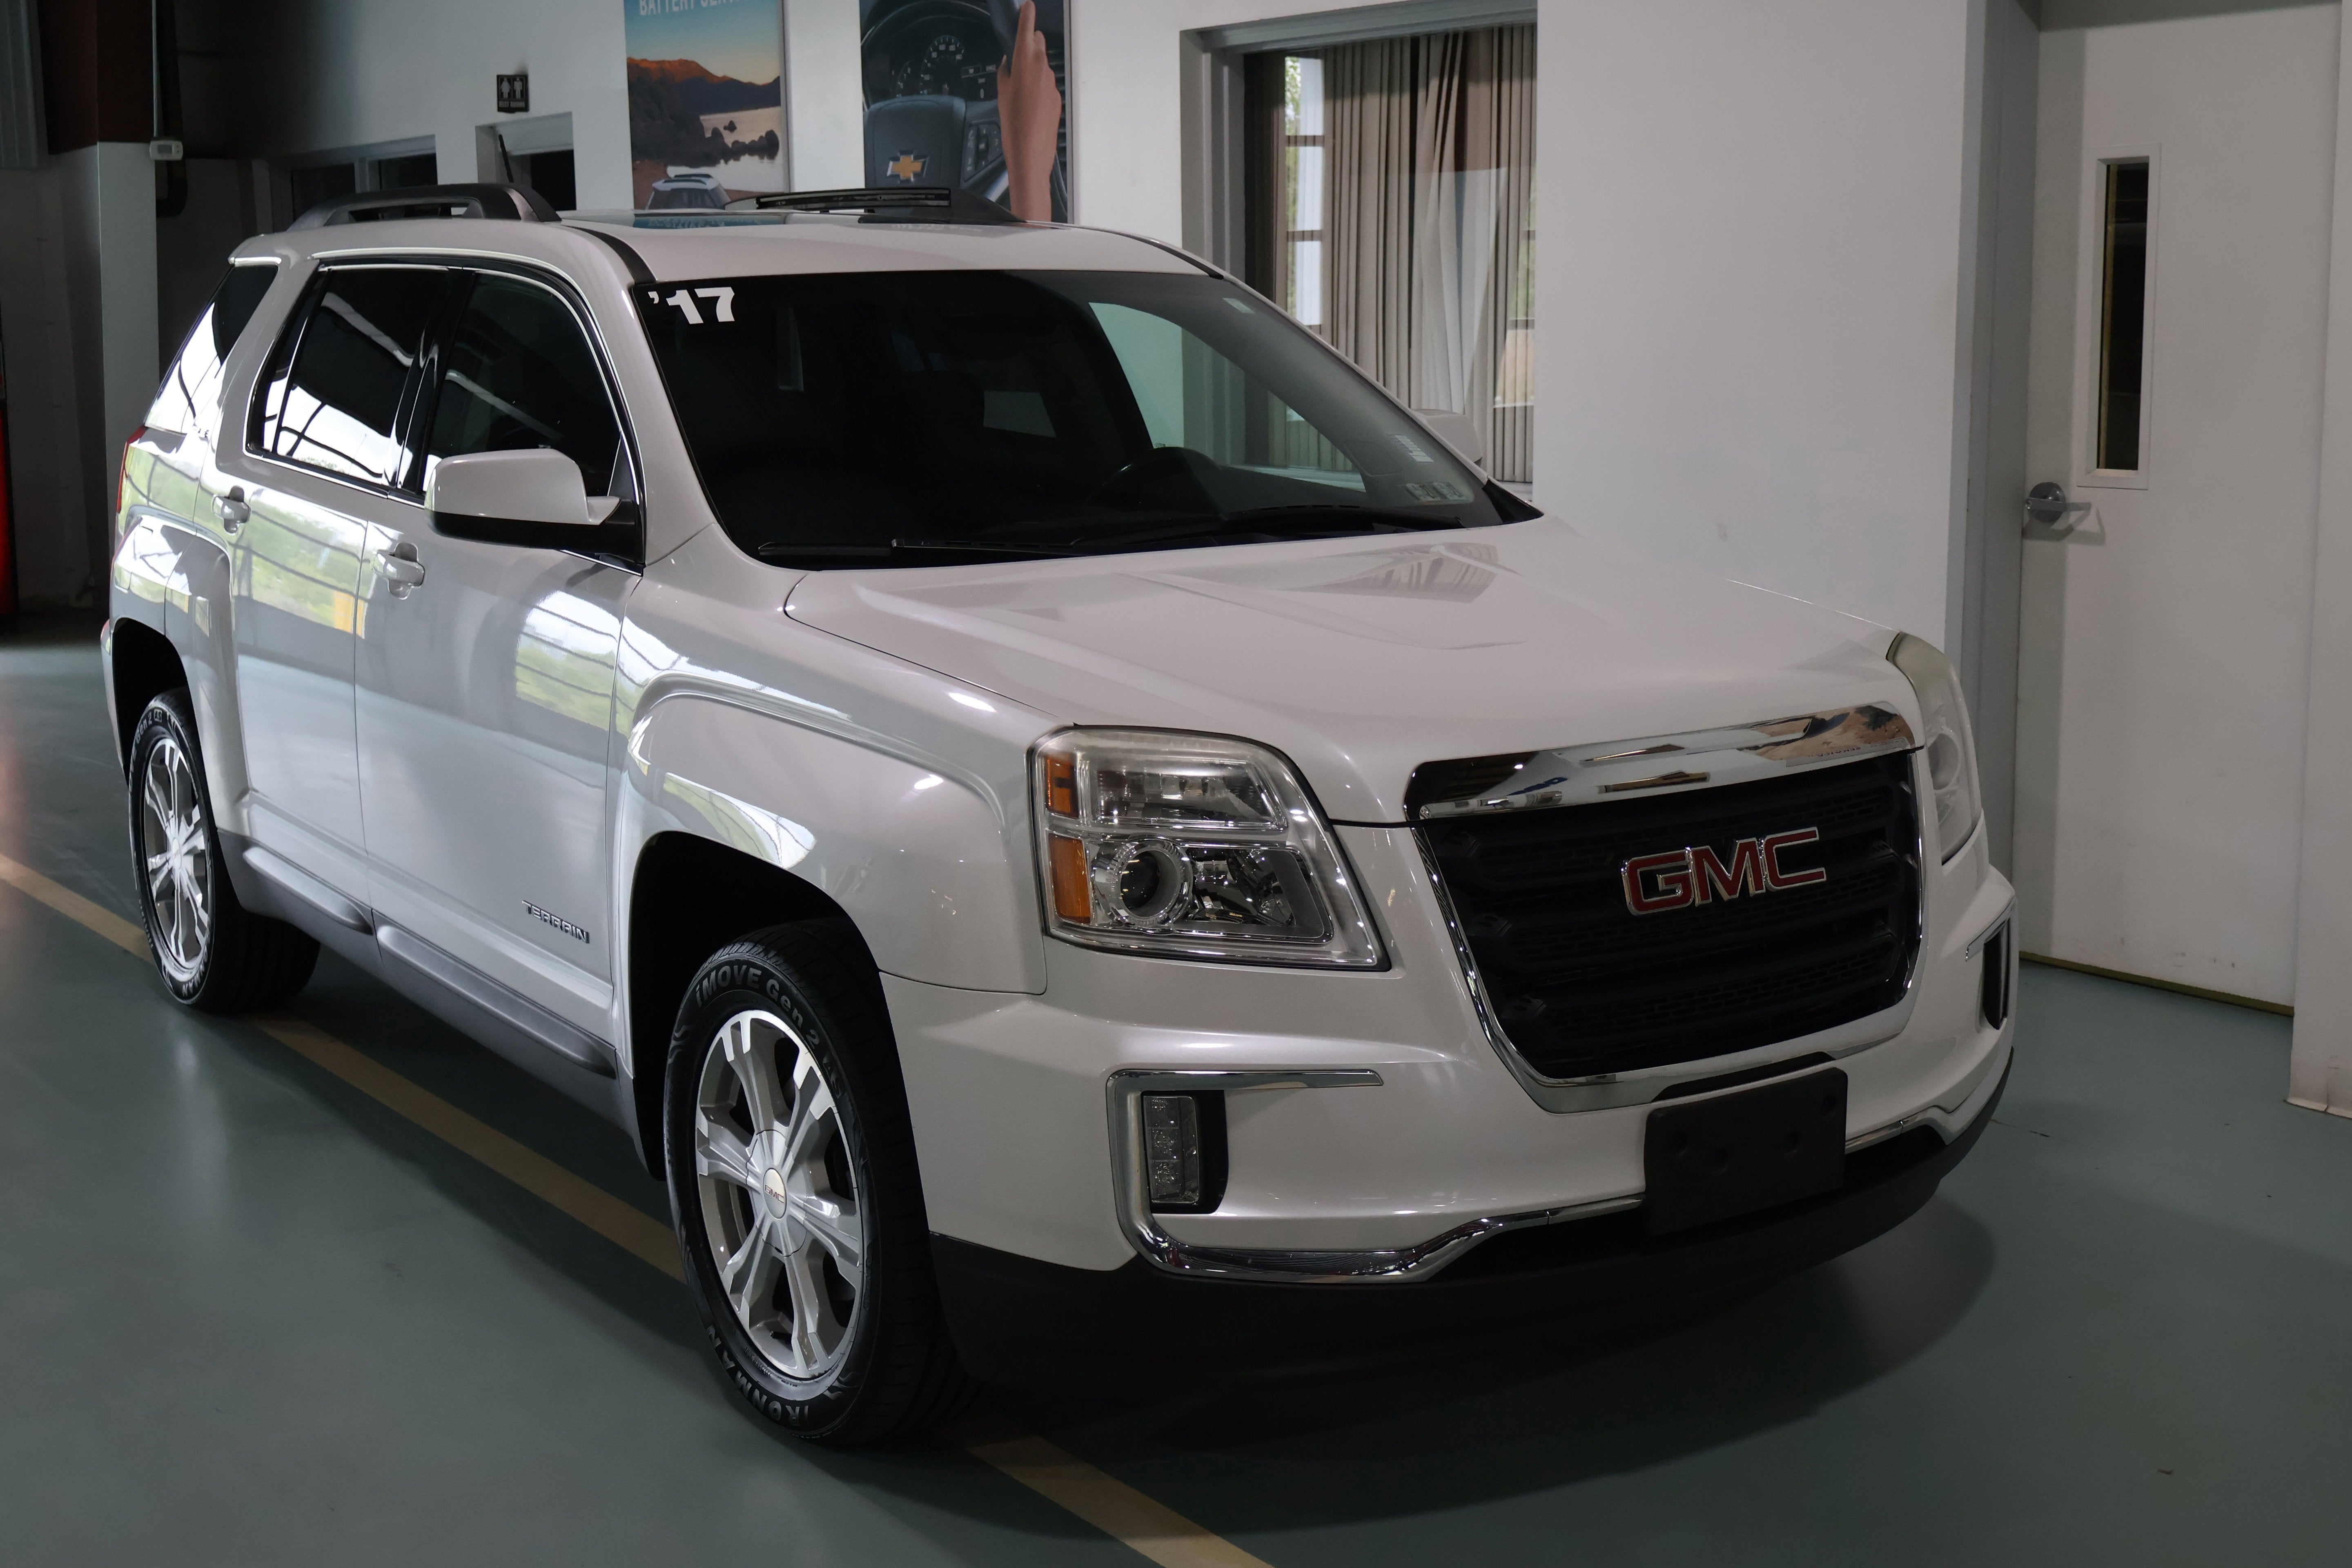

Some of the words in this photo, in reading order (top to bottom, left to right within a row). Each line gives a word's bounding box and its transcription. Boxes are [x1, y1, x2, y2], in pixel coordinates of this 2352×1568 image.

[648, 287, 735, 324] '17
[1620, 826, 1827, 916] GMC
[522, 900, 590, 944] TERRAIN
[696, 965, 762, 1007] iMOVE
[766, 978, 804, 1029] Gen
[806, 1029, 820, 1050] 2
[764, 1185, 784, 1203] GMC
[706, 1325, 809, 1426] IRONMAN
